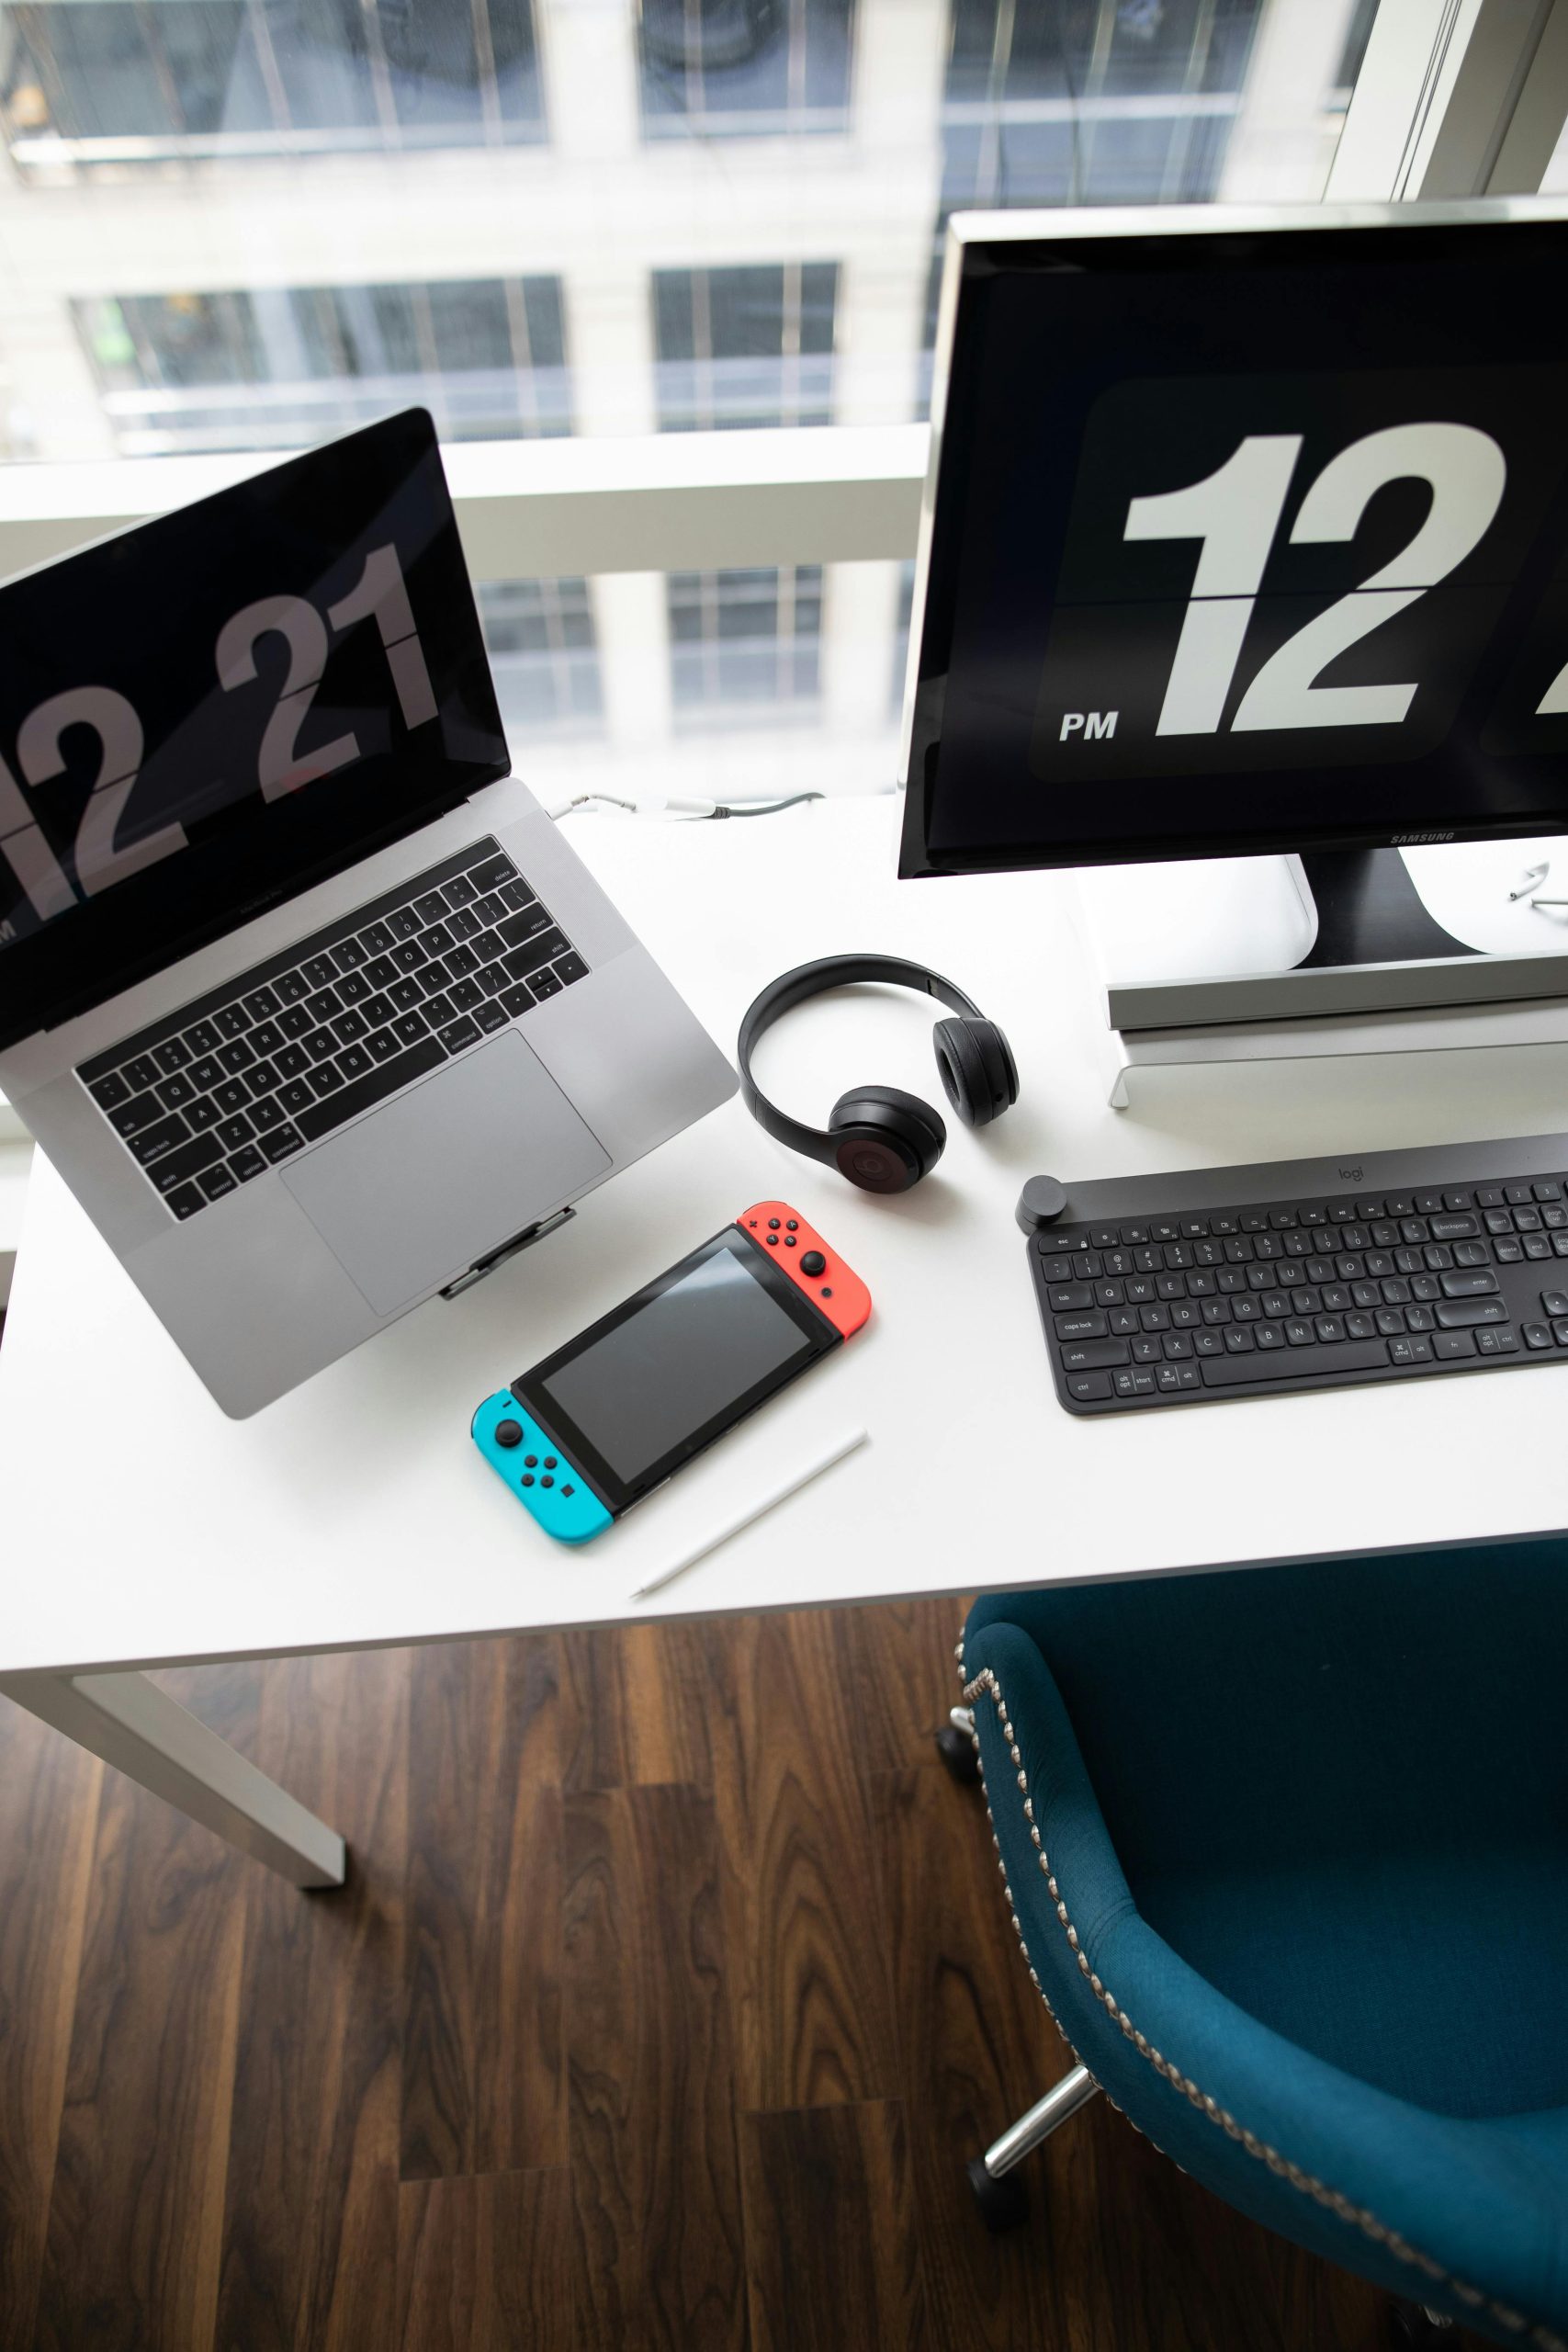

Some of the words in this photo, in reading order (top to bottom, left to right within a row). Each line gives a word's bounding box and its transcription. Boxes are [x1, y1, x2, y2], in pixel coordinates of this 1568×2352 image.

[1122, 421, 1507, 737] 12
[215, 542, 439, 804] 21
[1058, 710, 1119, 741] PM
[1390, 831, 1454, 843] SAMSUNG
[495, 870, 510, 882] delete
[531, 919, 546, 930] return
[432, 936, 439, 945] P
[552, 943, 564, 953] shift
[348, 955, 356, 963] 8
[319, 971, 326, 979] 7
[348, 984, 357, 993] U
[401, 990, 411, 998] K
[261, 1004, 270, 1013] 5
[232, 1021, 240, 1030] 4
[290, 1017, 298, 1026] T
[486, 1016, 502, 1029] option
[345, 1022, 354, 1032] H
[405, 1023, 416, 1032] M
[201, 1038, 210, 1047] 3
[261, 1035, 271, 1043] R
[316, 1039, 325, 1048] G
[451, 1031, 476, 1050] command
[377, 1040, 387, 1049] N
[171, 1056, 180, 1064] 2
[231, 1052, 241, 1061] E
[287, 1056, 294, 1065] F
[349, 1057, 358, 1066] B
[200, 1068, 211, 1078] W
[257, 1074, 267, 1083] D
[320, 1074, 328, 1082] V
[171, 1087, 181, 1095] Q
[228, 1091, 237, 1100] S
[291, 1092, 300, 1100] C
[198, 1110, 207, 1118] A
[261, 1109, 271, 1118] X
[231, 1127, 241, 1137] Z
[1338, 1166, 1364, 1182] logi
[1167, 1282, 1174, 1290] E
[1105, 1289, 1114, 1297] Q
[1151, 1313, 1158, 1322] S
[1265, 1331, 1272, 1339] B
[1204, 1338, 1212, 1346] C
[1143, 1345, 1150, 1353] Z
